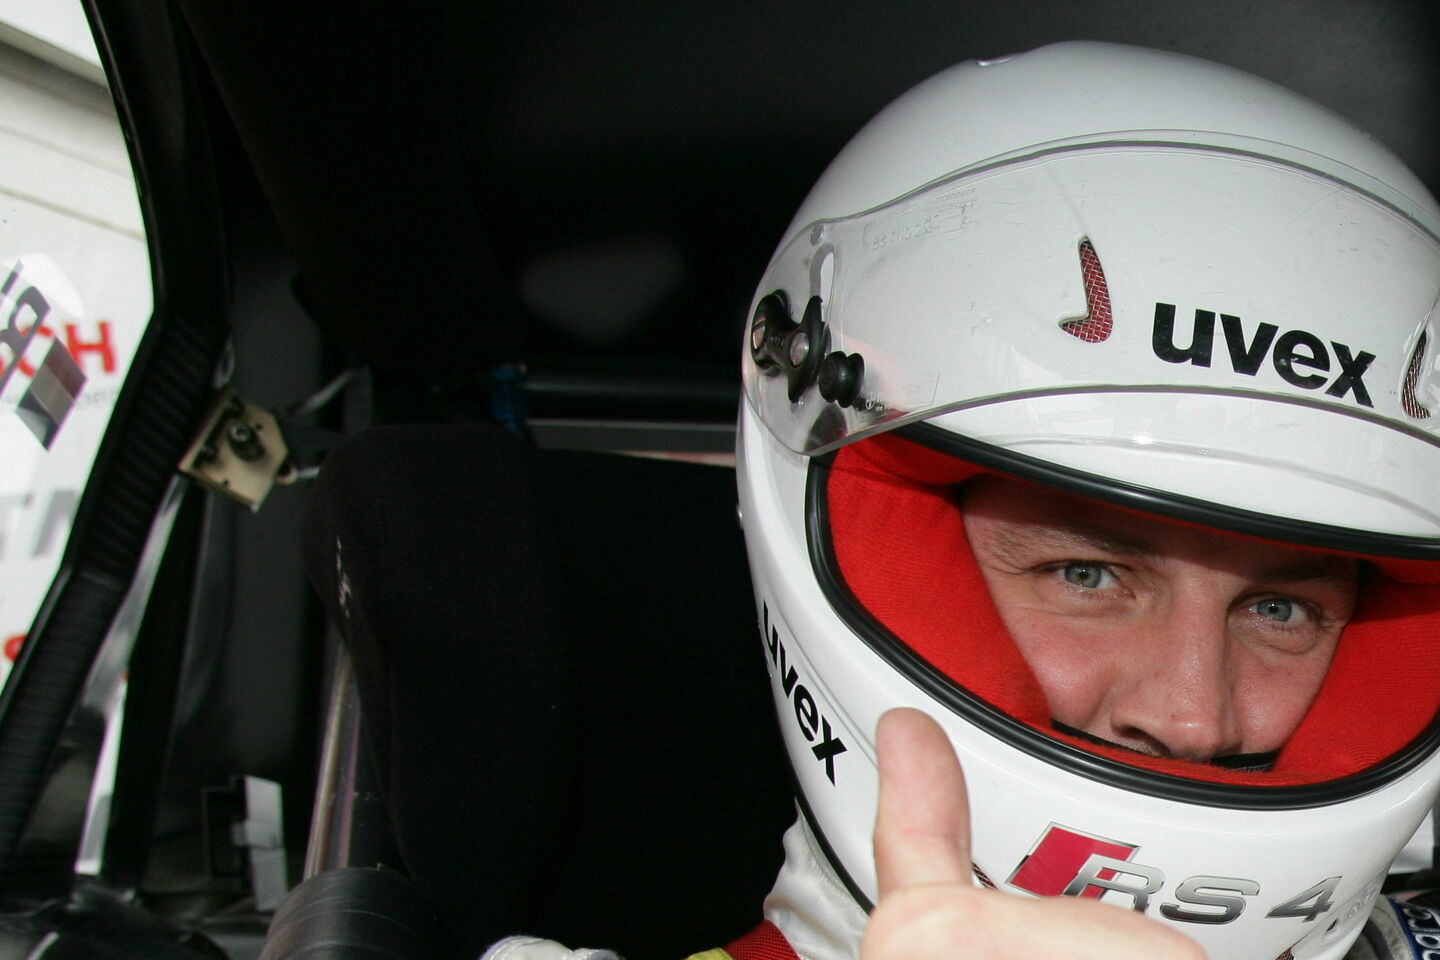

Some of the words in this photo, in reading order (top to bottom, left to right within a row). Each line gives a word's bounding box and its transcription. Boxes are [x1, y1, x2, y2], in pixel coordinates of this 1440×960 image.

[1152, 301, 1376, 409] uvex
[763, 600, 849, 788] uvex
[1264, 875, 1343, 922] 4
